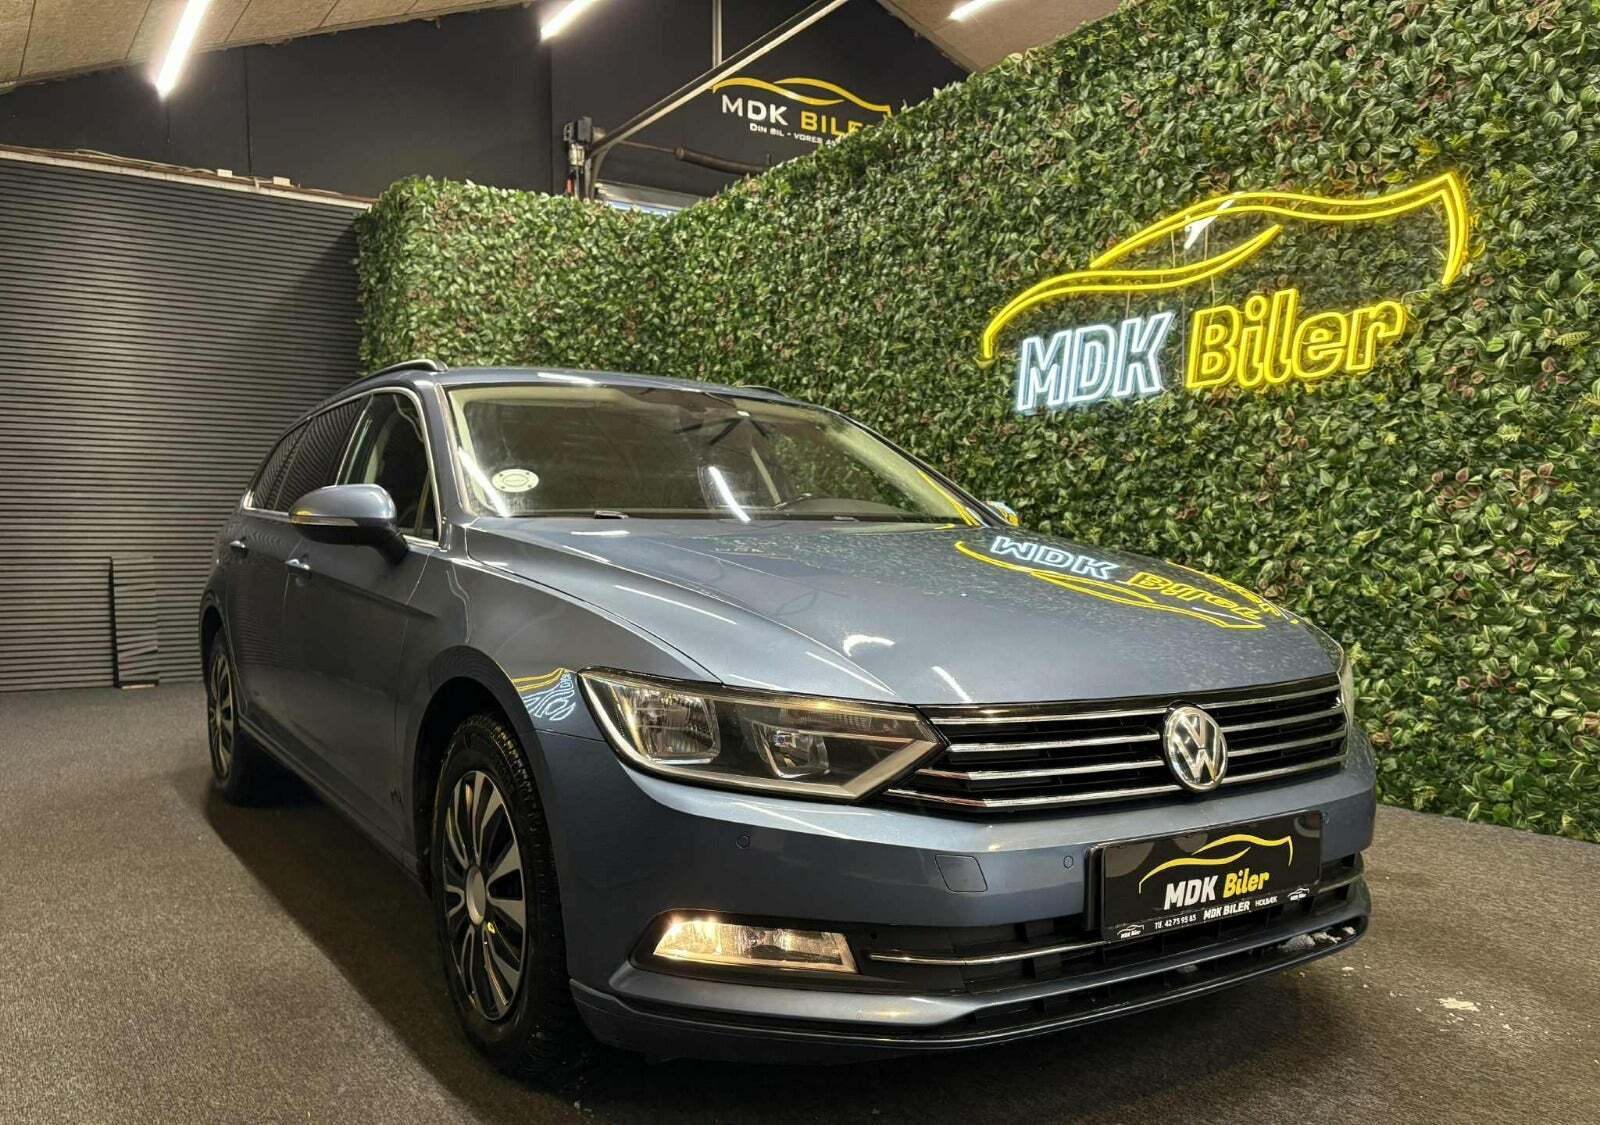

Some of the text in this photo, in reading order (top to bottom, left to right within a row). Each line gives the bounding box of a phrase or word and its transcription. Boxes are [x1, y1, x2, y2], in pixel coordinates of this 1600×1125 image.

[721, 94, 867, 140] MDK BILE
[1016, 288, 1406, 411] MDK Biler
[1164, 868, 1269, 910] MDK Biler
[1203, 900, 1250, 920] MDK BILER
